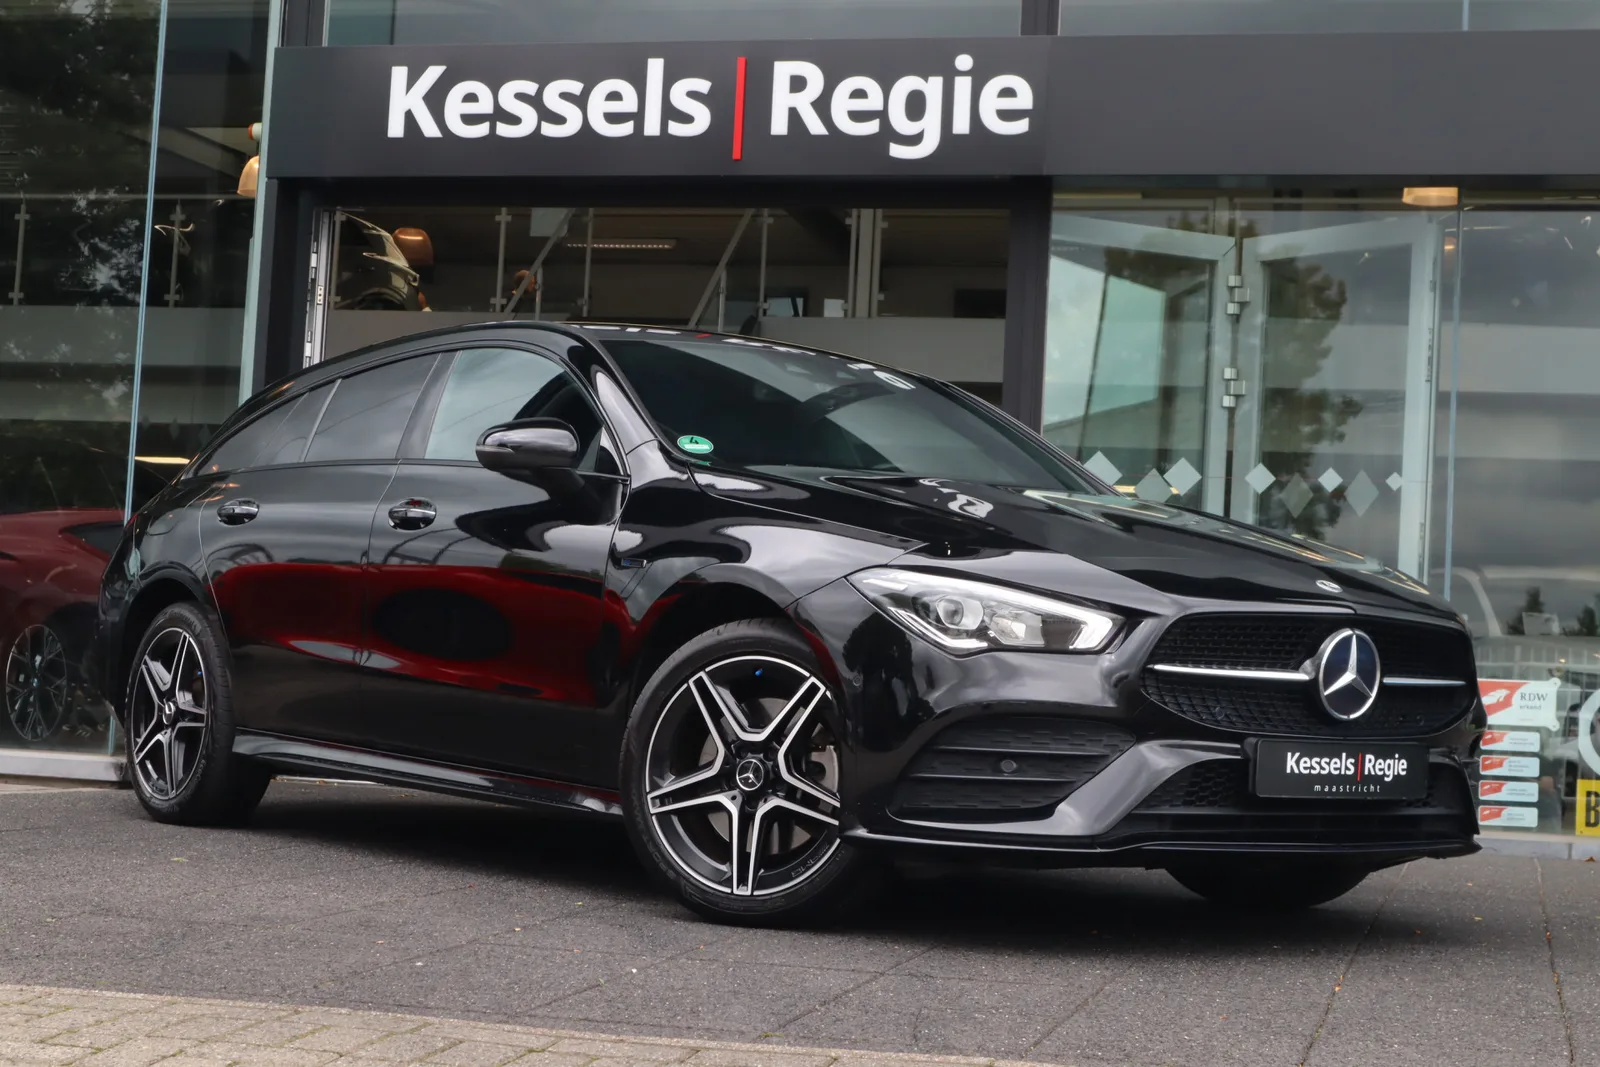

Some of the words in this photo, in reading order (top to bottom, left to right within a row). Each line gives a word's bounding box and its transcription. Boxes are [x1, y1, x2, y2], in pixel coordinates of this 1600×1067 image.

[387, 57, 713, 139] Kessels
[770, 53, 1034, 160] Regie
[1519, 692, 1548, 702] RDW
[1286, 752, 1355, 775] Kessels
[1364, 753, 1408, 782] Regie
[1313, 784, 1380, 793] maastricht
